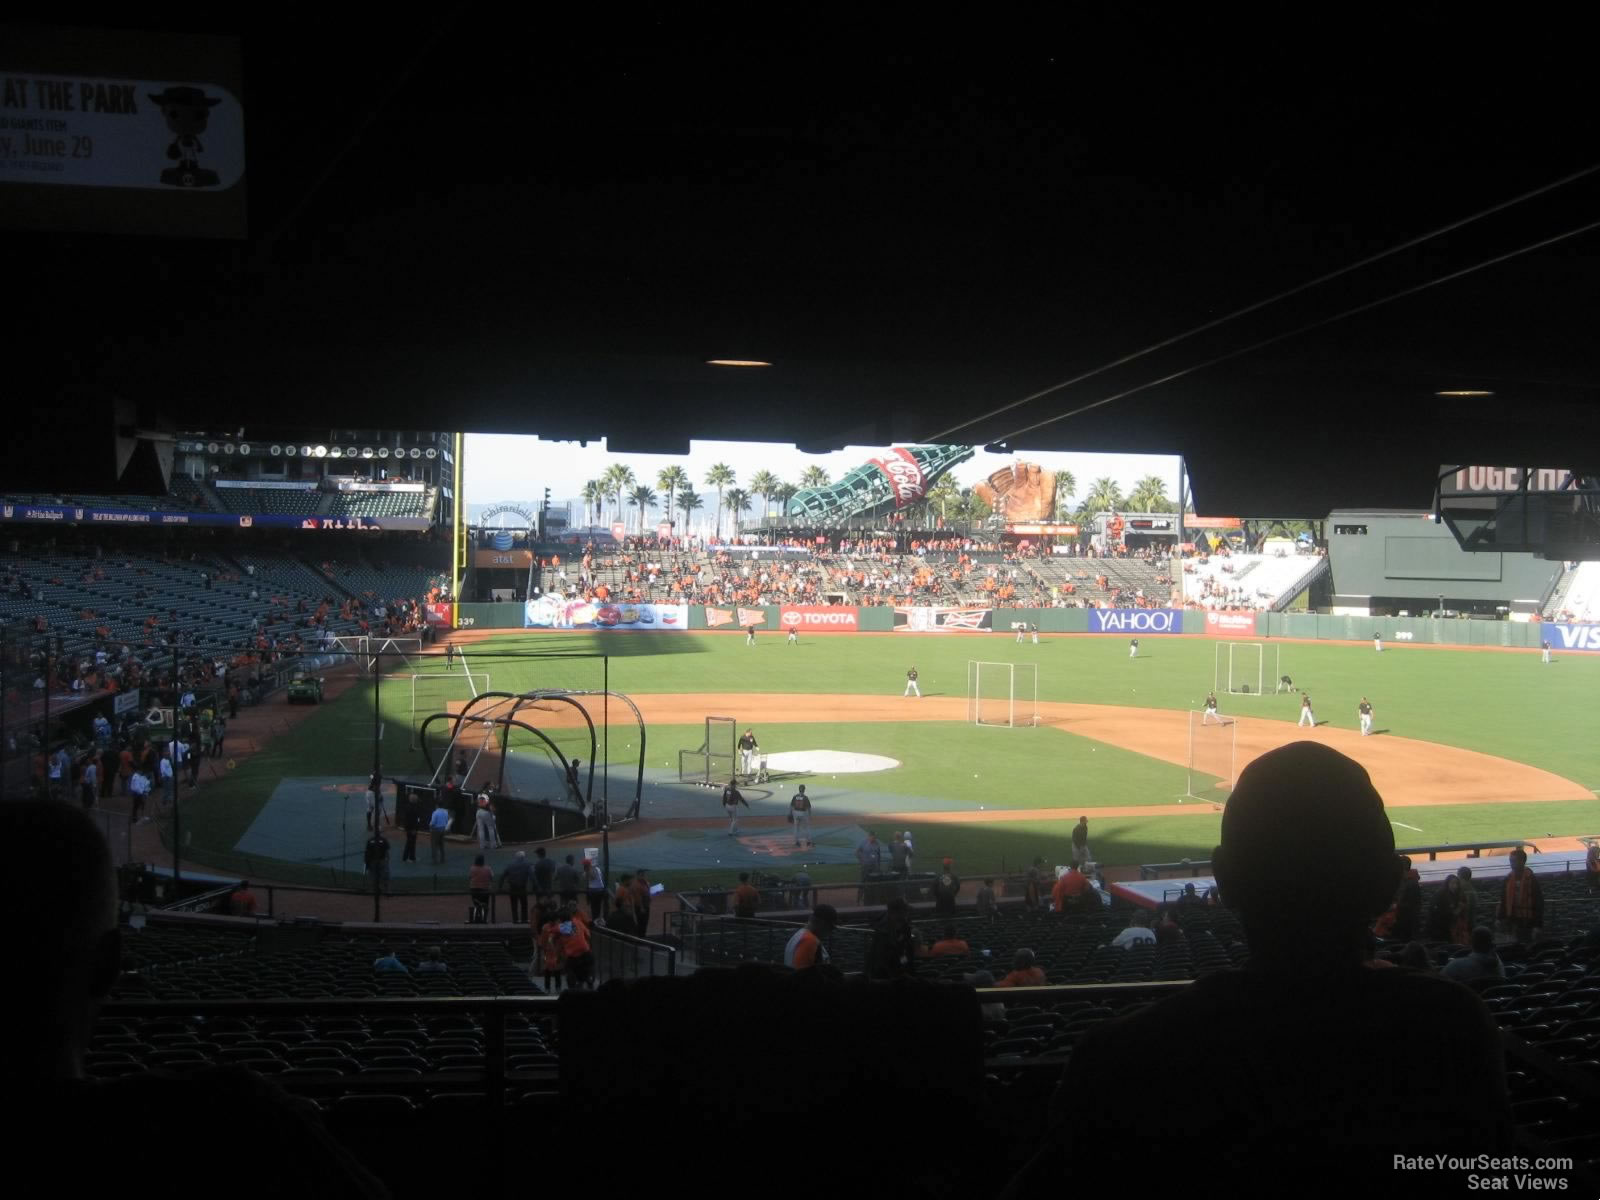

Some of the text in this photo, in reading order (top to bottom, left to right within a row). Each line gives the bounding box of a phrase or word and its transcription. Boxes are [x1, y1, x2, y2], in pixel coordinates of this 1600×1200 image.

[4, 78, 137, 115] AT THE PARK
[24, 133, 65, 157] June
[71, 135, 93, 159] 29
[886, 461, 923, 501] Cola
[492, 556, 513, 564] at&t
[458, 617, 475, 626] 339
[804, 613, 855, 624] TOYOTA
[1095, 611, 1172, 632] YAHOO!
[1395, 631, 1413, 640] 399
